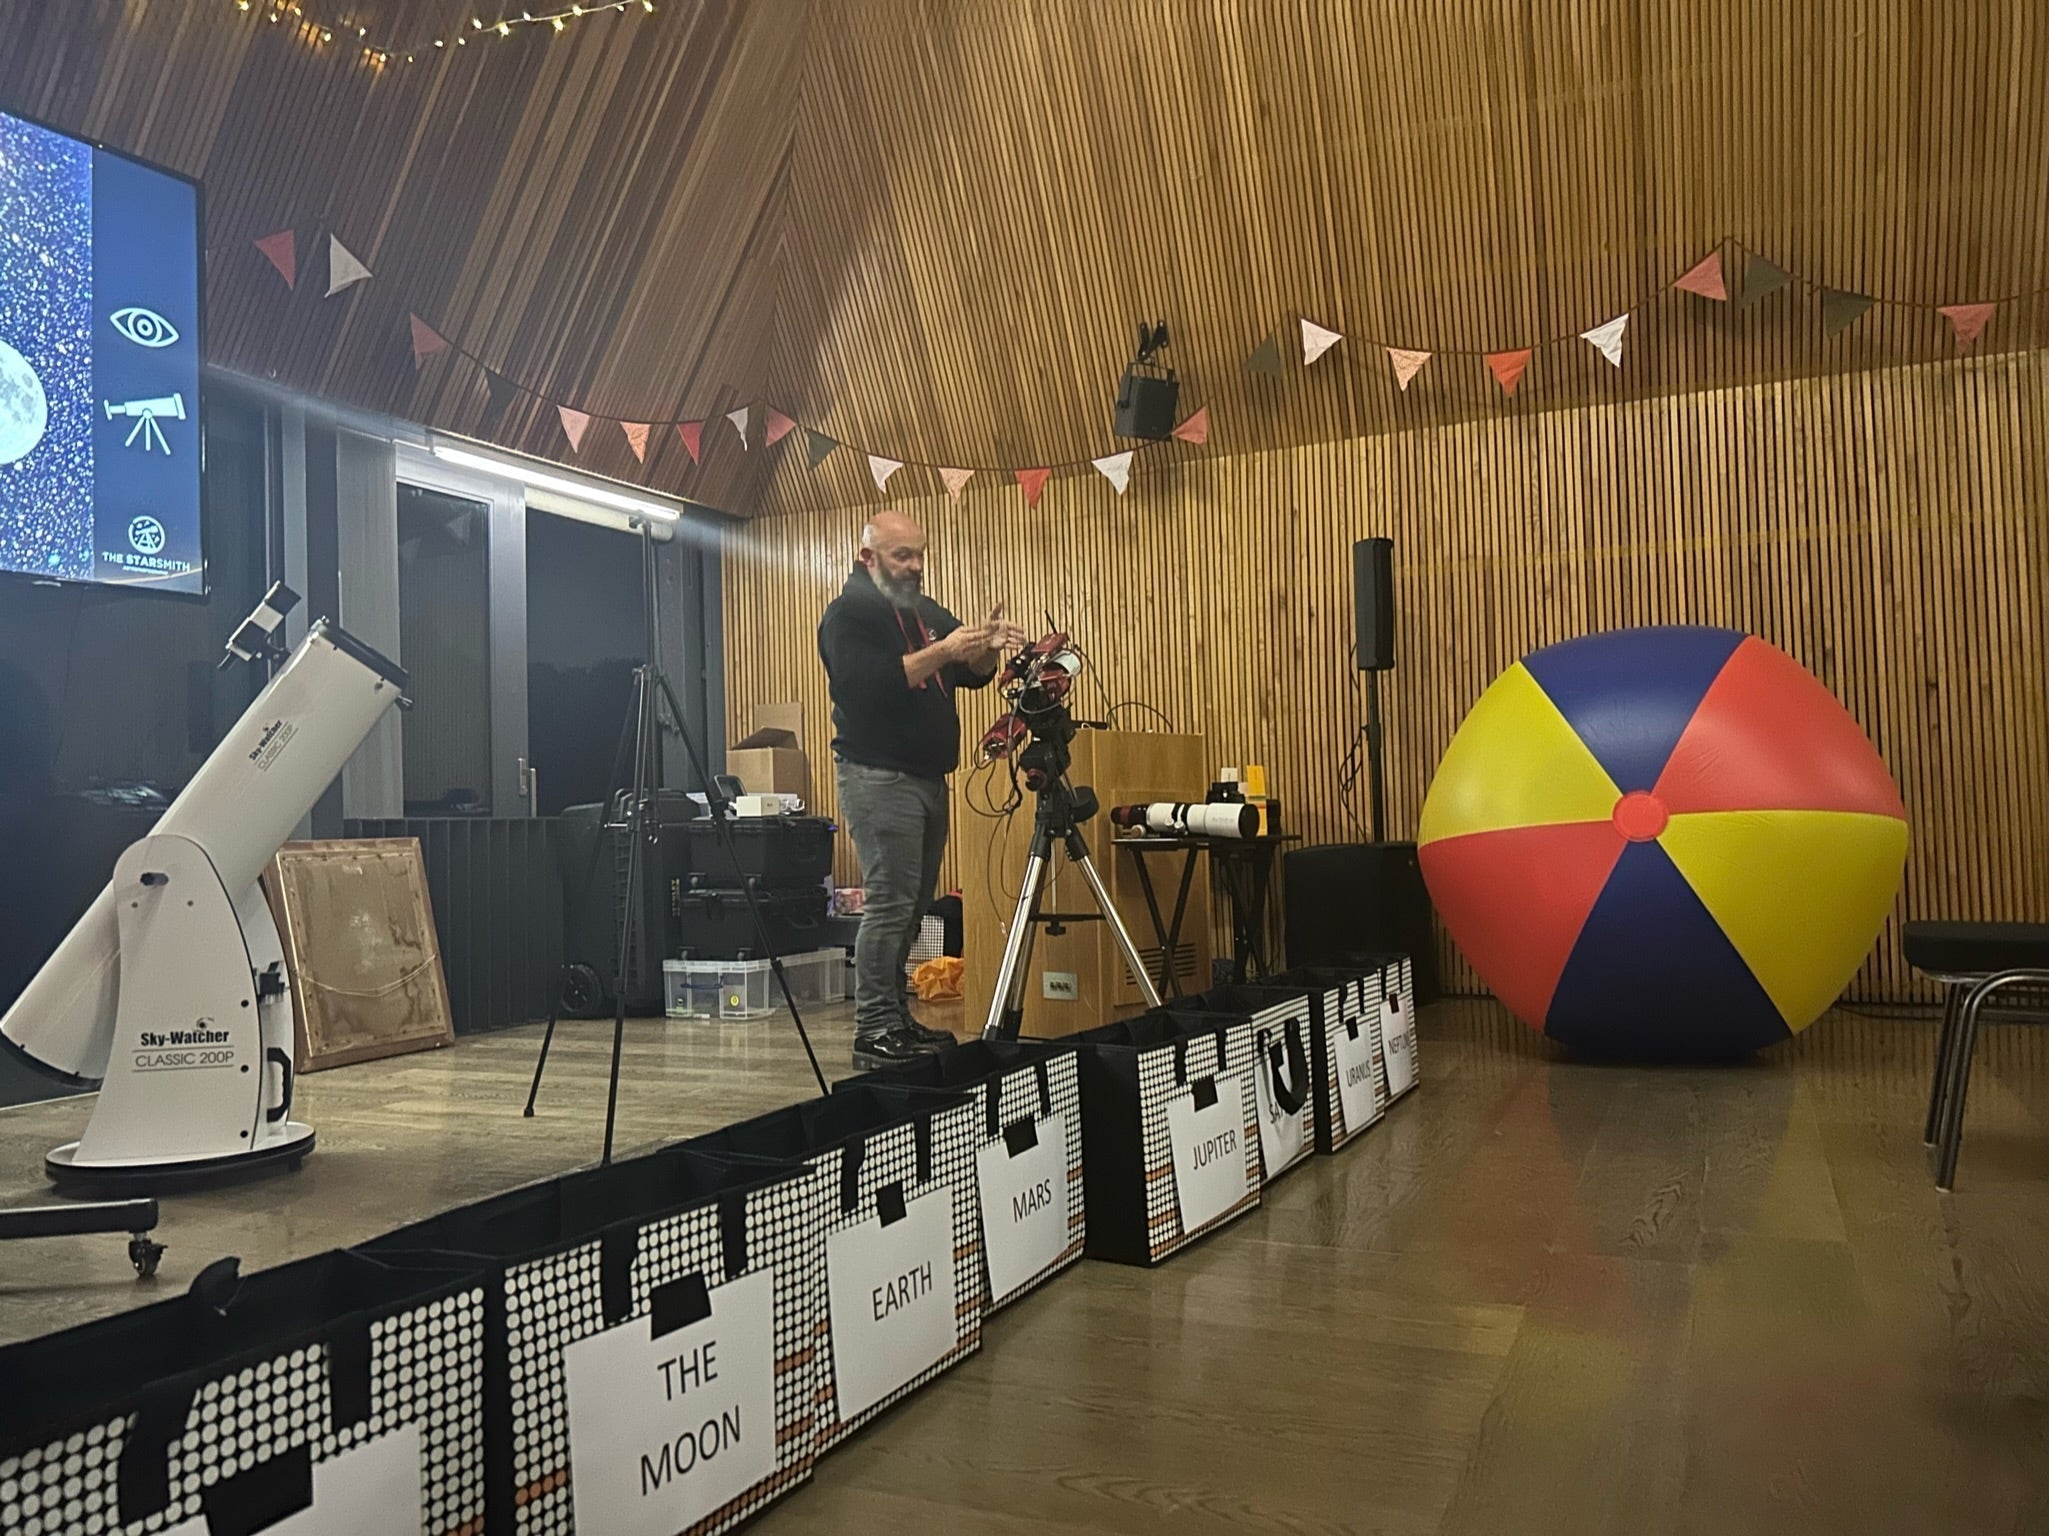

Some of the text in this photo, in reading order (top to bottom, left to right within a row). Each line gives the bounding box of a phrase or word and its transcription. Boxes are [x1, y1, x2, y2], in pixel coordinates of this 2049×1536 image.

[102, 551, 124, 565] THE
[126, 553, 191, 573] STARSMITH
[248, 719, 282, 761] Sky-Watcher
[257, 741, 282, 770] CLASSIC
[135, 1050, 234, 1068] CLASSIC 200P
[140, 1029, 230, 1047] Sky-Watcher
[1346, 1059, 1371, 1088] URANUS
[1192, 1129, 1238, 1171] JUPITER
[1012, 1178, 1052, 1223] MARS
[871, 1260, 933, 1322] EARTH
[657, 1340, 718, 1401] THE
[641, 1404, 741, 1497] MOON
